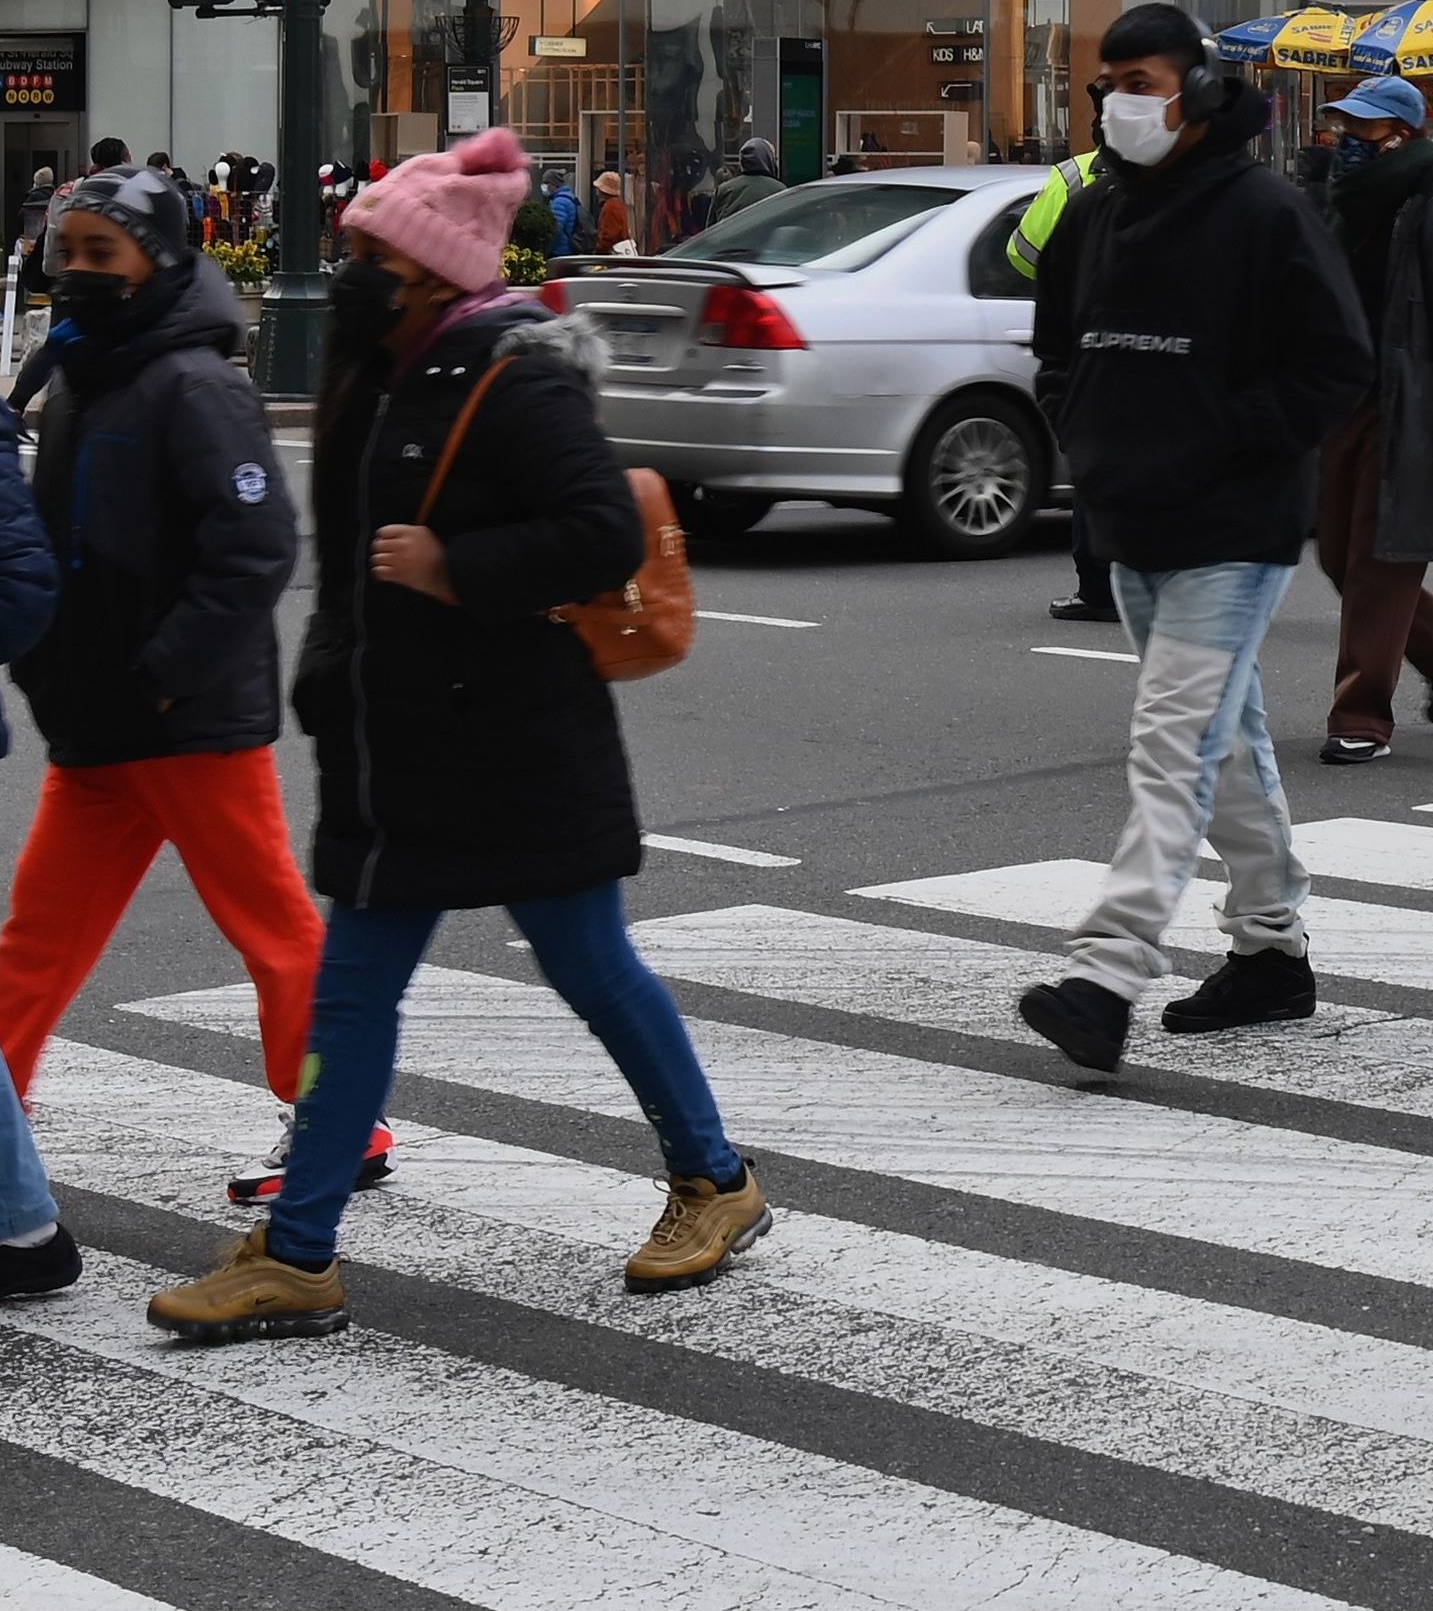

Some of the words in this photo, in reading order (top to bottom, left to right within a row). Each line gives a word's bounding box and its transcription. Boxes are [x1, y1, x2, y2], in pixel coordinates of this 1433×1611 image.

[933, 48, 954, 62] KIDS
[36, 59, 72, 70] Station
[1080, 332, 1192, 354] SUPREME
